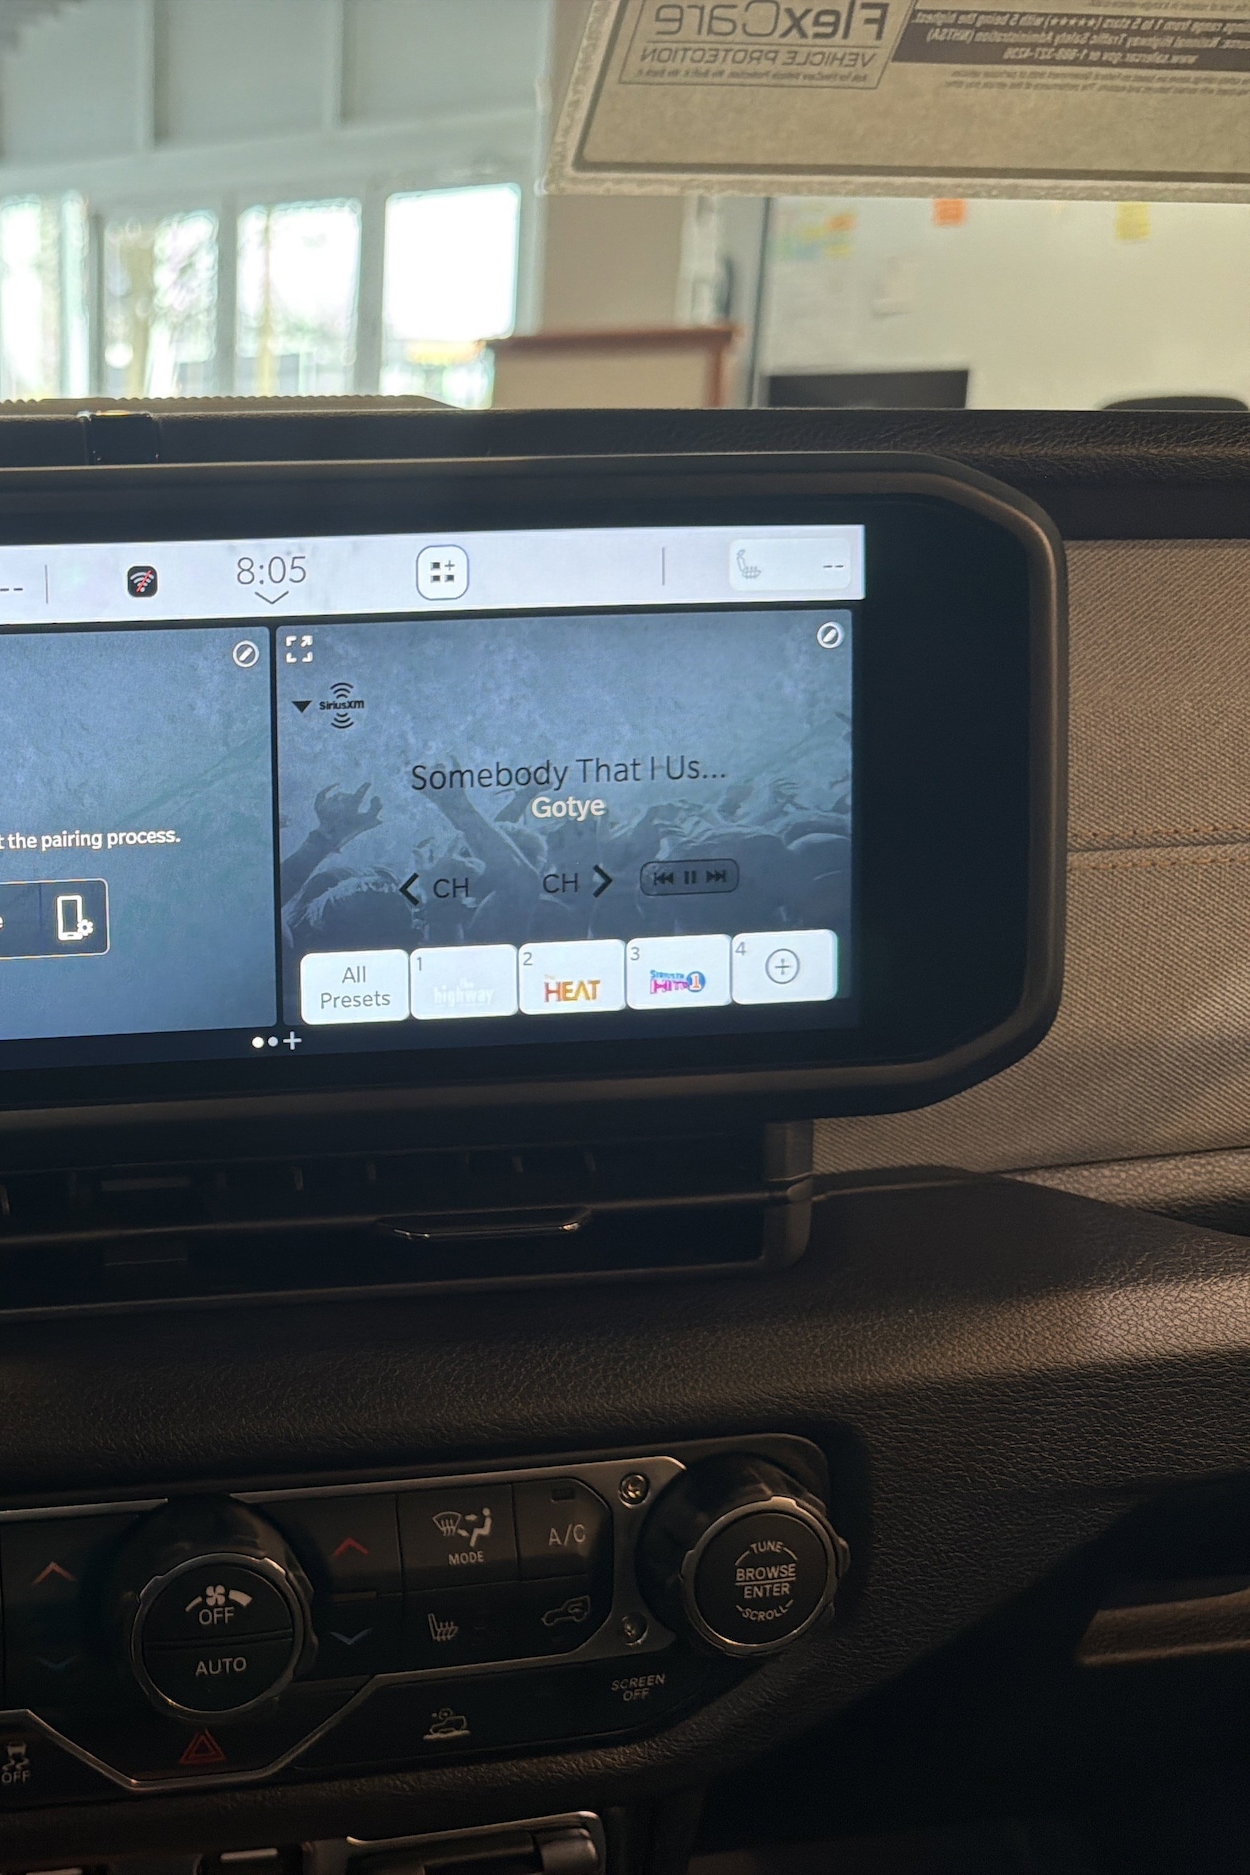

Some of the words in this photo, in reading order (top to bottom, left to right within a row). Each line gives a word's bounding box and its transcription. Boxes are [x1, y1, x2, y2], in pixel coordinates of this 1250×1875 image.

[236, 554, 308, 587] 8:05
[411, 758, 568, 791] Somebody
[576, 757, 642, 783] That
[531, 796, 606, 822] Gotye
[7, 832, 37, 849] the
[41, 829, 103, 852] pairing
[107, 828, 181, 850] process.
[433, 877, 470, 900] CH
[542, 873, 579, 895] CH
[522, 951, 533, 966] 2
[630, 946, 640, 961] 3
[734, 941, 746, 956] 4
[341, 965, 367, 984] All
[320, 989, 391, 1009] Presets
[544, 979, 601, 1003] HEAT
[548, 1523, 587, 1547] A/C
[750, 1540, 784, 1555] TUNE
[448, 1550, 485, 1566] MODE
[735, 1561, 797, 1582] BROWSE
[743, 1581, 791, 1600] ENTER
[198, 1605, 235, 1627] OFF
[741, 1603, 789, 1622] SCROLL
[195, 1656, 248, 1678] AUTO
[611, 1673, 666, 1692] SCREEN
[623, 1686, 650, 1702] OFF
[1, 1770, 31, 1785] OFF
